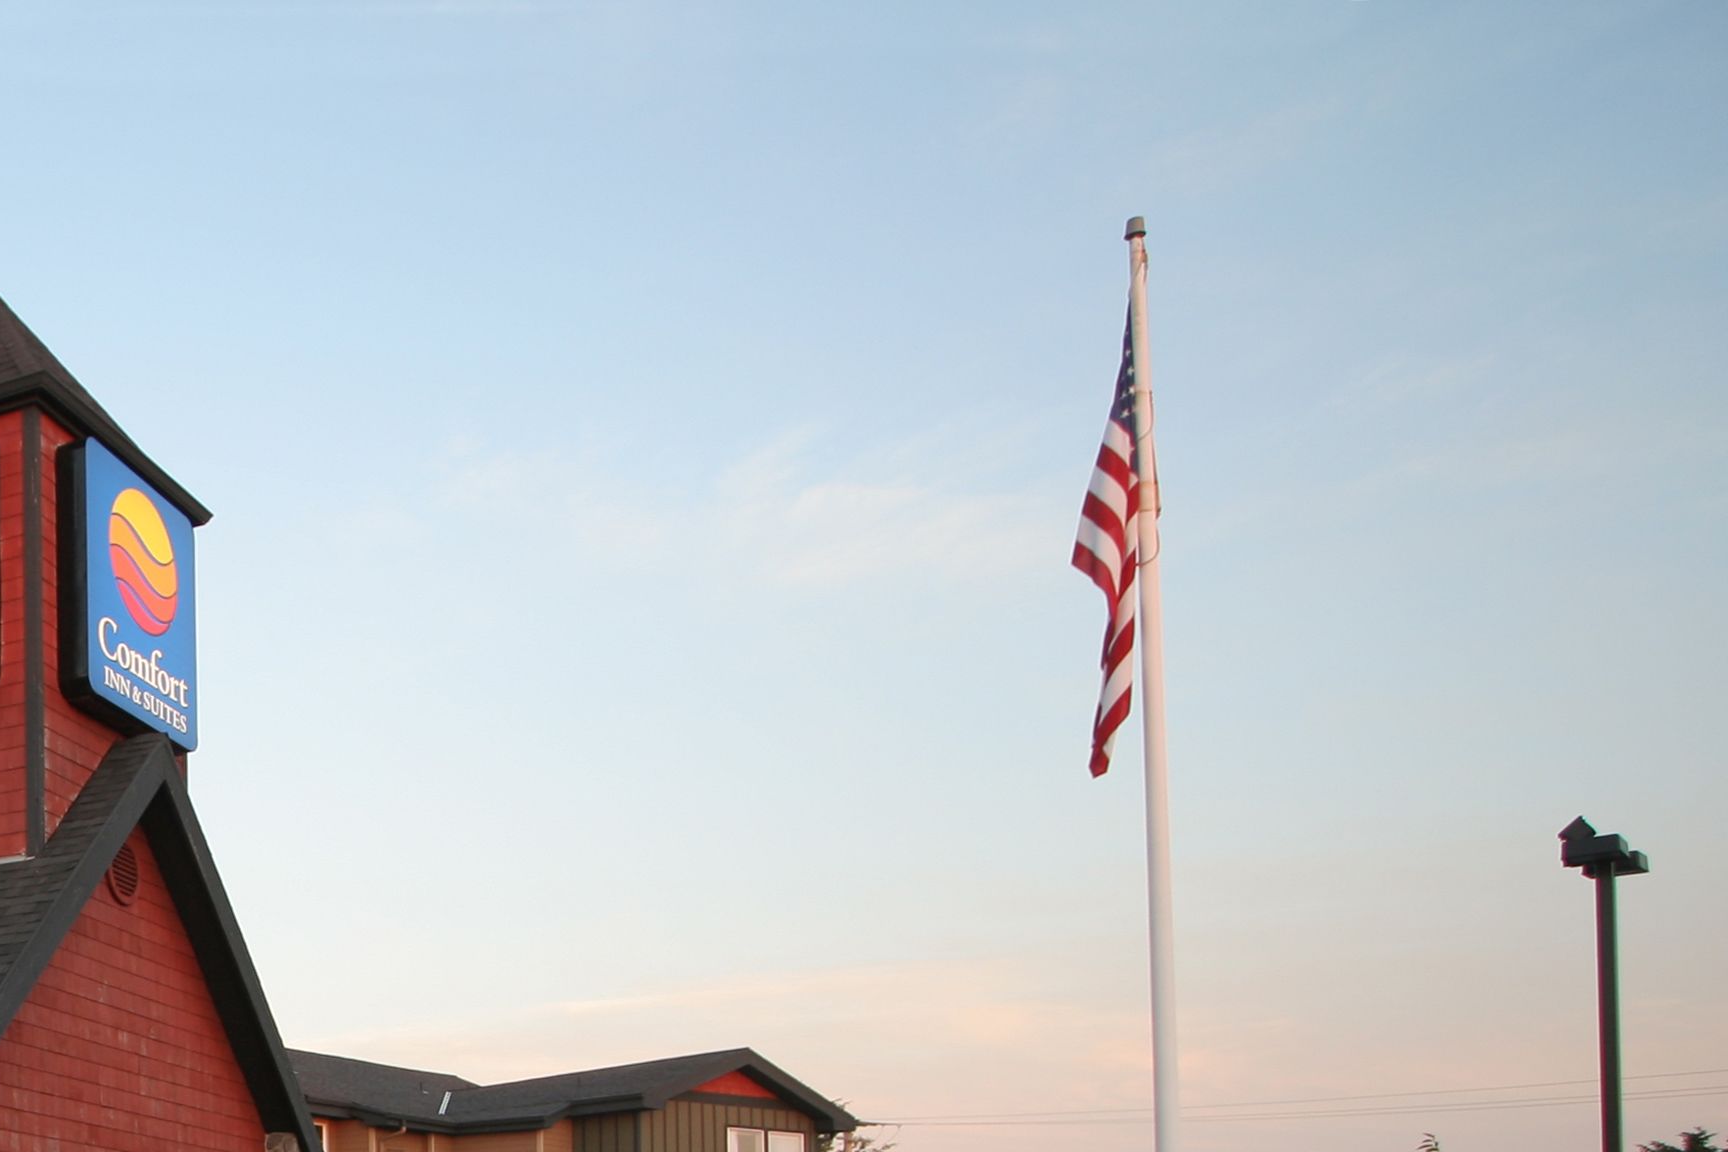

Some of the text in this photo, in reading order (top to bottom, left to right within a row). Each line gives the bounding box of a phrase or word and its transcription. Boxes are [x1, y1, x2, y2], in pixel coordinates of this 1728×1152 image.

[98, 616, 189, 708] Comfort
[103, 665, 187, 734] INN & SUITES
